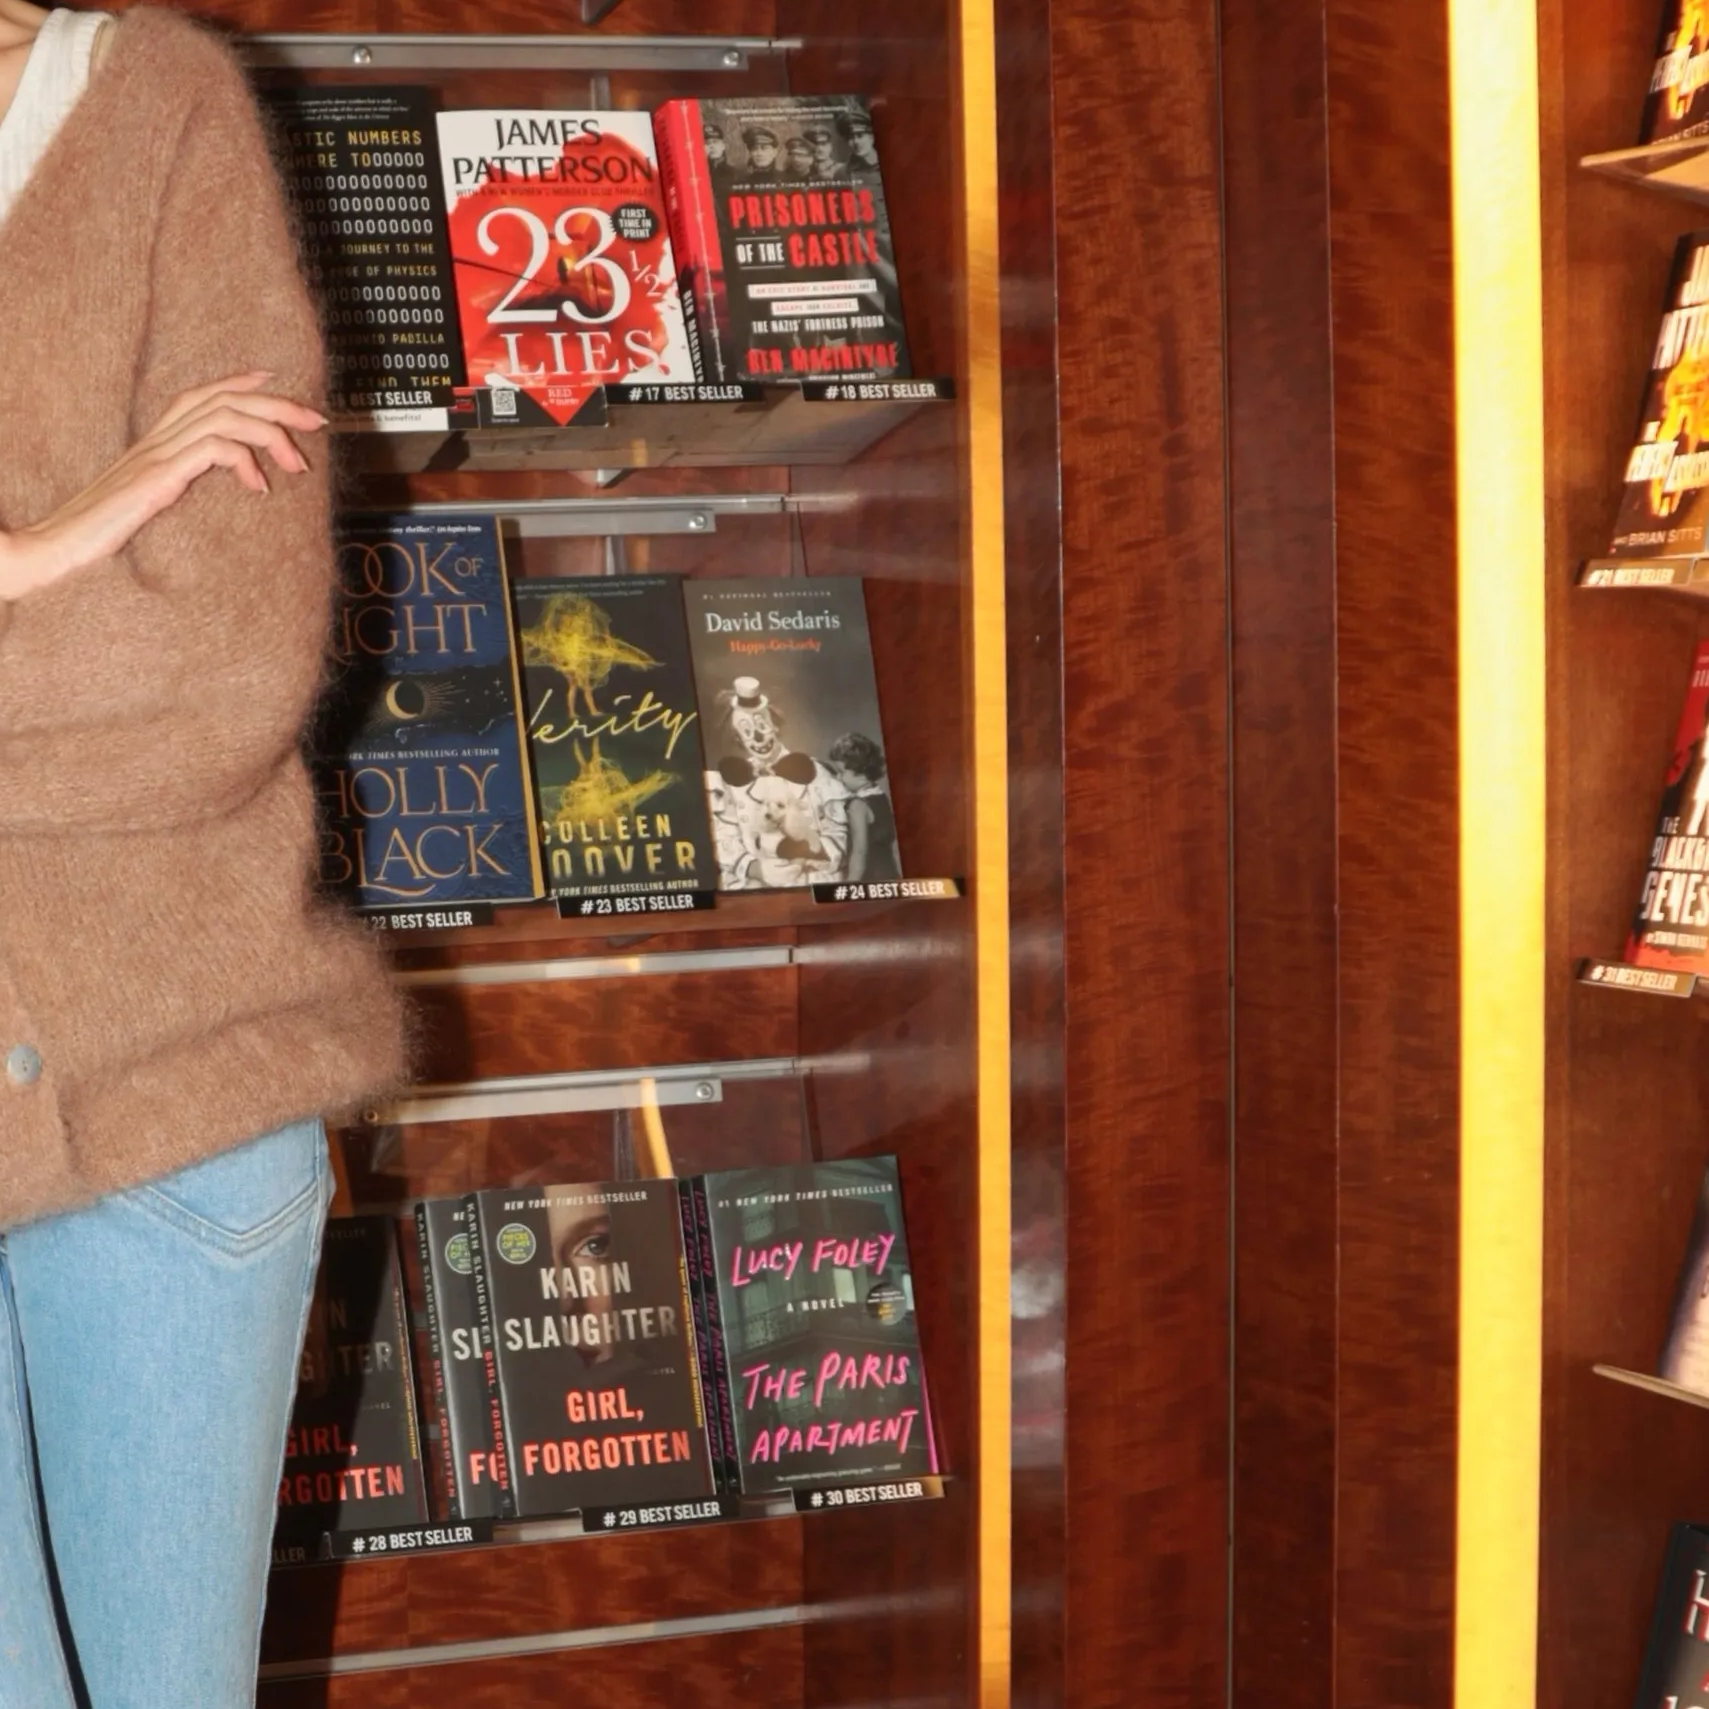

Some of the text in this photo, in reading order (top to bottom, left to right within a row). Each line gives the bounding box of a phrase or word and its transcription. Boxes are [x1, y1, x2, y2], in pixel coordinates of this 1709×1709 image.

[494, 118, 602, 150] JAMES
[453, 155, 655, 185] PATTERSON
[623, 227, 650, 238] PRINT
[498, 331, 662, 376] LIES
[665, 386, 698, 401] BEST
[701, 385, 744, 400] SELLER
[705, 609, 841, 633] David Sedaris
[730, 1234, 895, 1287] LUCY FOLEY
[539, 1261, 632, 1299] KARIN
[504, 1306, 678, 1351] SLAUGHTER
[750, 1408, 919, 1463] APARTMENT
[522, 1431, 692, 1477] FORGOTTEN
[642, 1505, 678, 1525] BEST
[680, 1501, 720, 1520] SELLER
